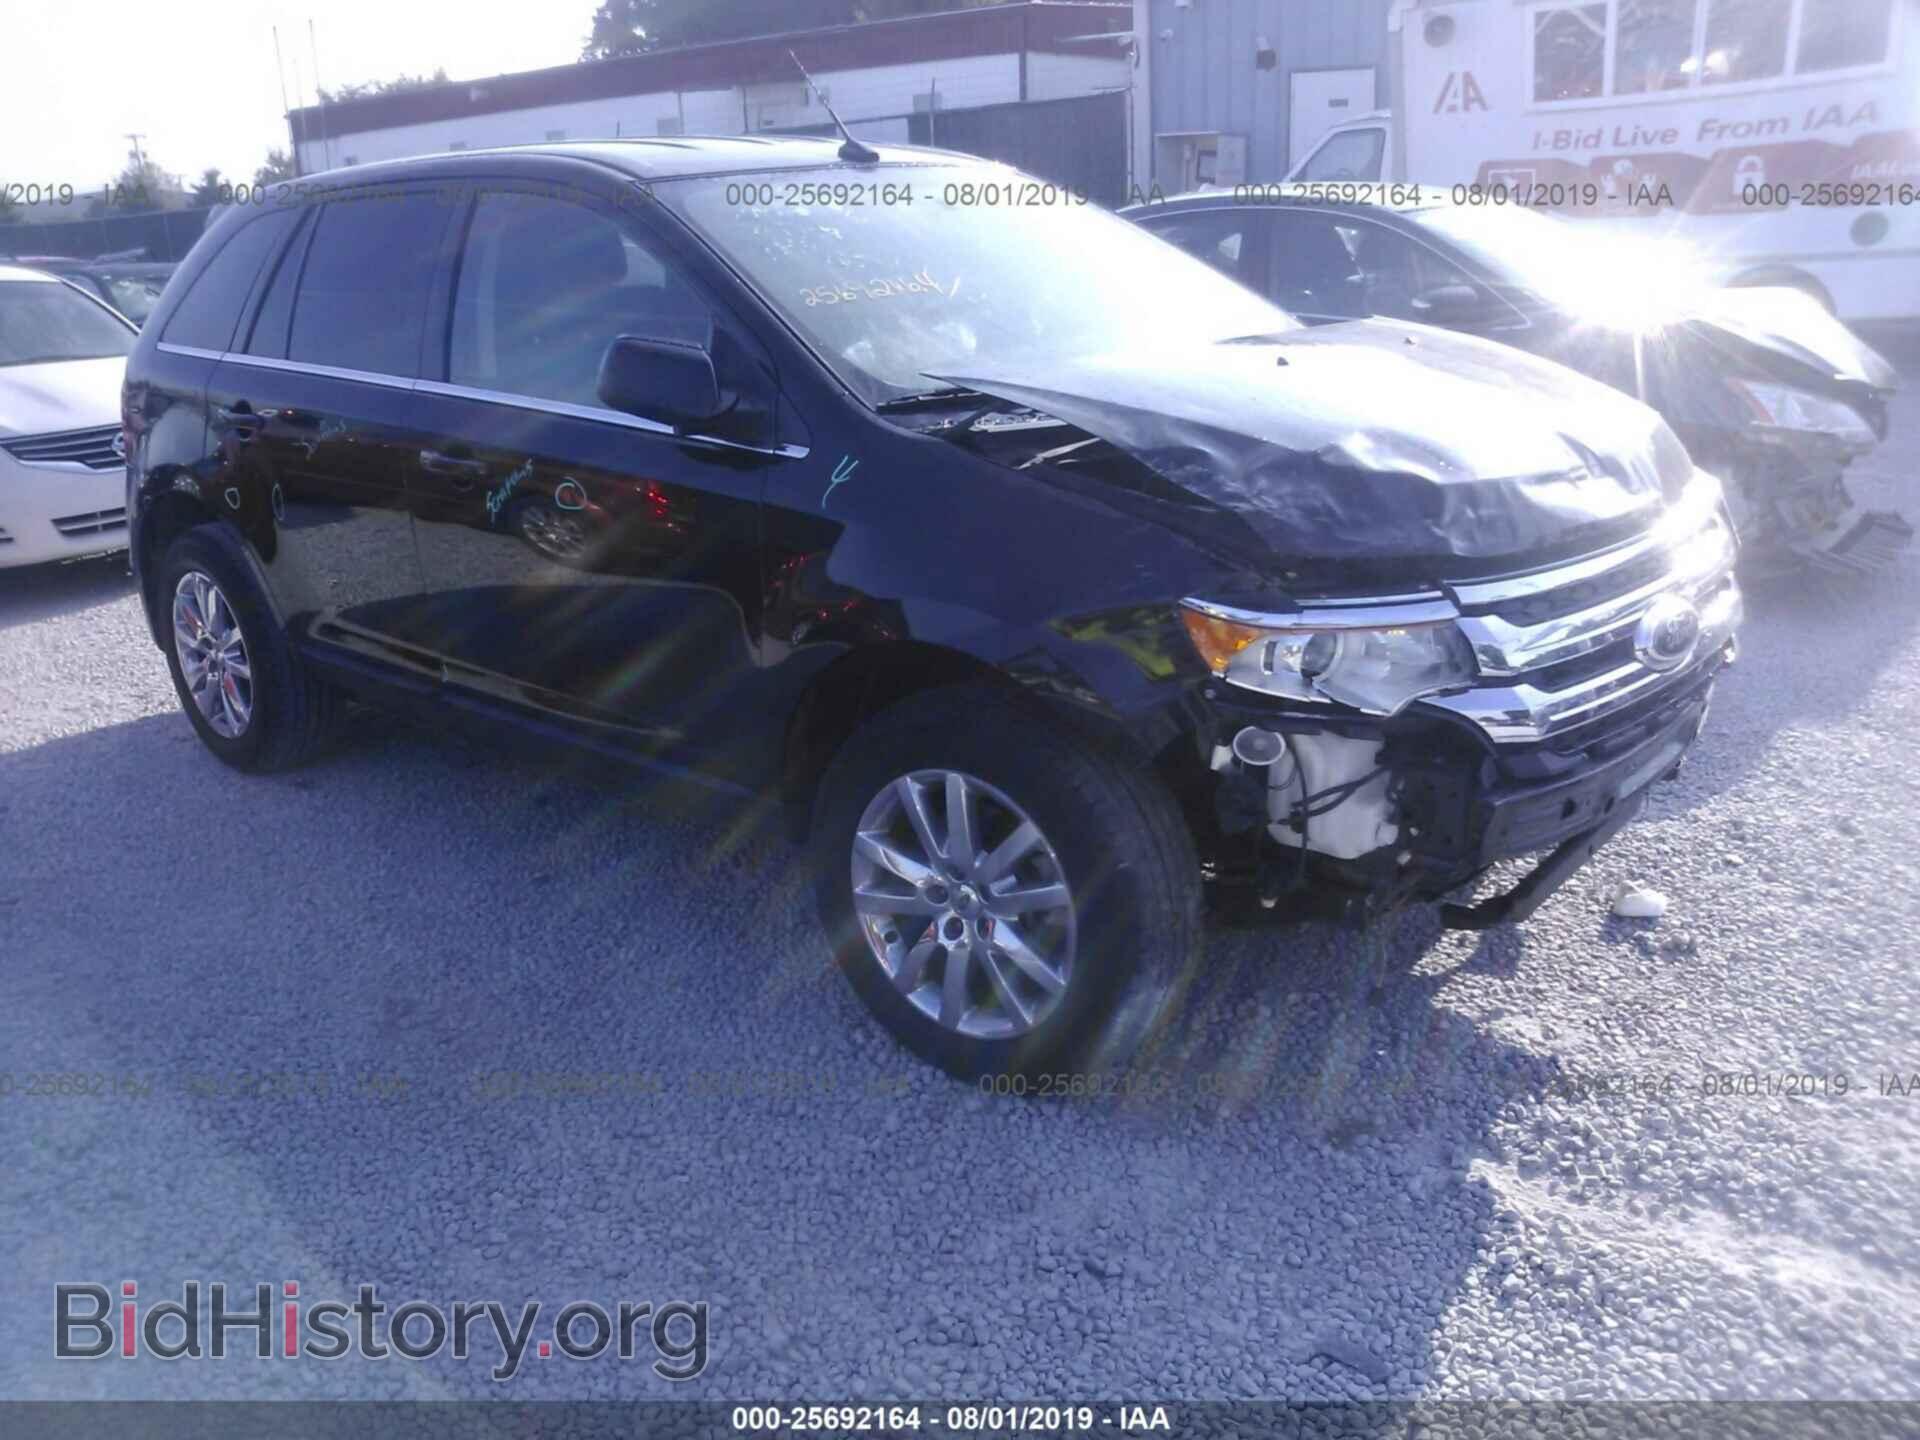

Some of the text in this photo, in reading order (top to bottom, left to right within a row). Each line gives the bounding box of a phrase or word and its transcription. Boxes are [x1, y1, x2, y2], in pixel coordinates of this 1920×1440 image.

[1533, 101, 1878, 150] I-Bid Live From IAA
